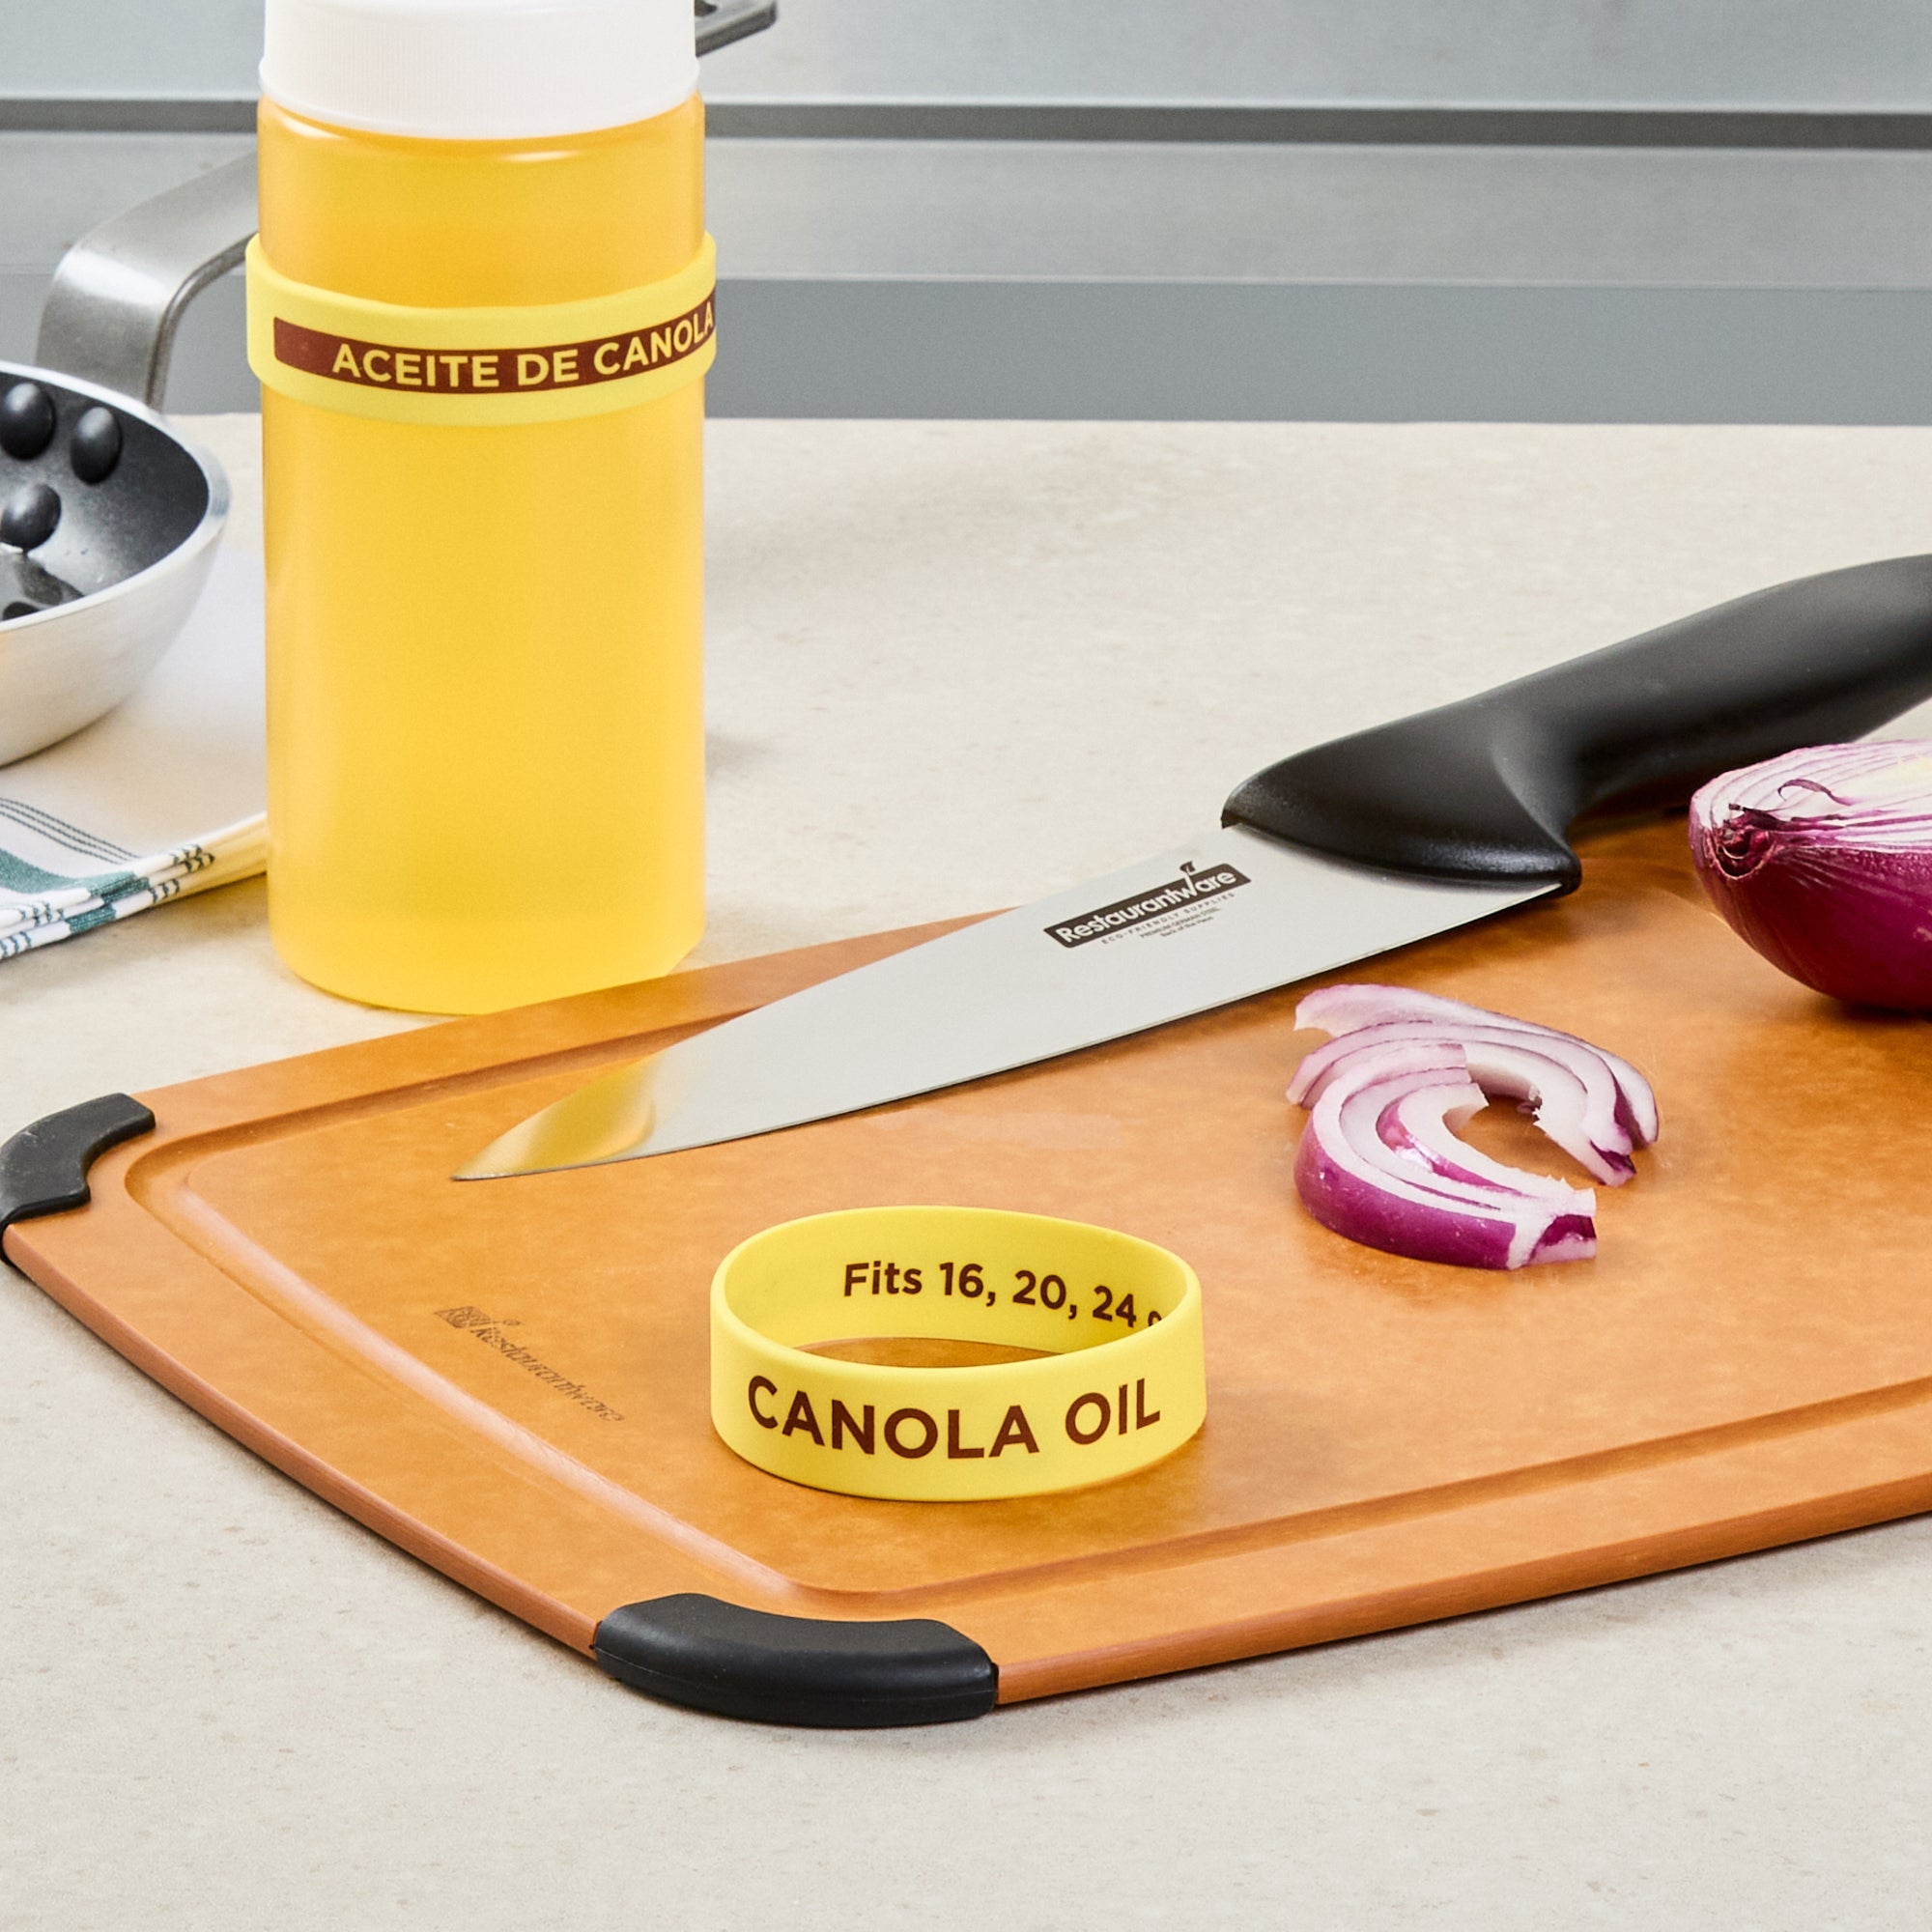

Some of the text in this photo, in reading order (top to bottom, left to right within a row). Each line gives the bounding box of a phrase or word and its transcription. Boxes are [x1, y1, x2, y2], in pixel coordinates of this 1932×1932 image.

[332, 300, 714, 387] ACEITE DE CANOLA
[1054, 866, 1236, 943] Restaurantware
[1100, 912, 1179, 945] ECO-FRIENDLY
[1183, 892, 1236, 916] SUPPLIES
[844, 1261, 923, 1296] Fits
[939, 1262, 996, 1307] 16,
[1012, 1270, 1078, 1320] 20,
[1092, 1286, 1138, 1327] 24
[748, 1375, 1162, 1460] CANOLA OIL
